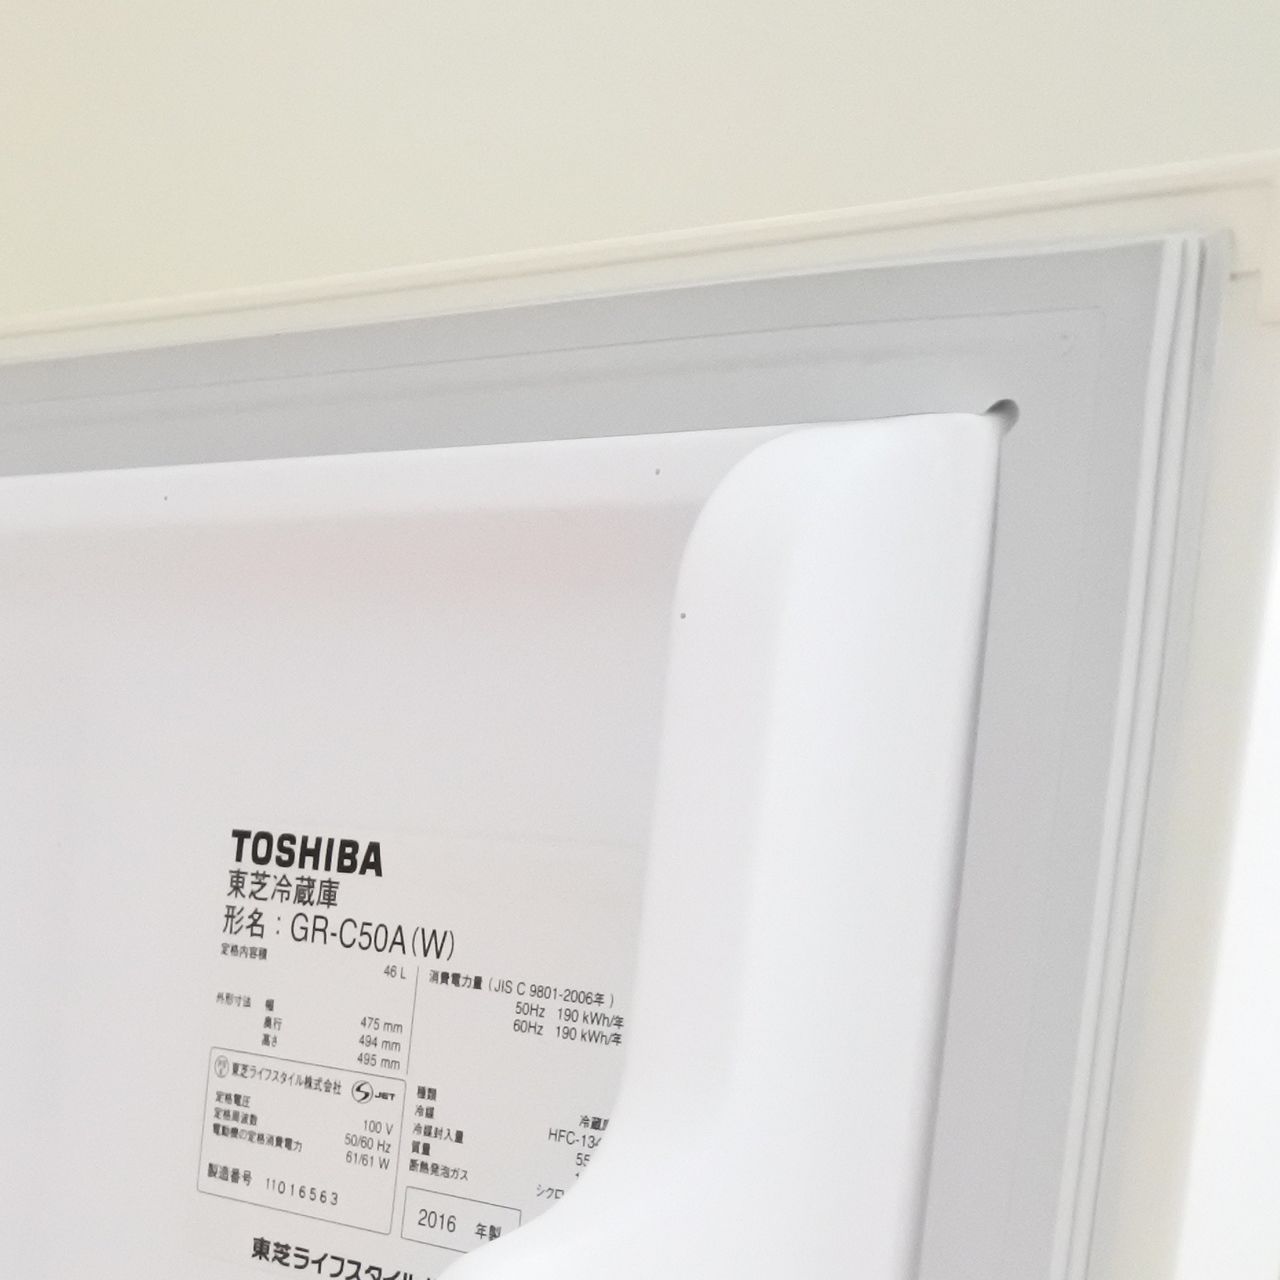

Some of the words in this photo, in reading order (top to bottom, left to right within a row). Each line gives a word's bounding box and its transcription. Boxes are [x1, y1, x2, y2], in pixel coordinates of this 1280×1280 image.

[232, 829, 383, 877] TOSHIBA
[227, 868, 340, 909] 東芝冷蔵庫
[383, 965, 397, 979] 46
[400, 967, 407, 980] L
[515, 1001, 545, 1018] 50Hz
[557, 1008, 579, 1023] 190
[360, 1016, 380, 1031] 475
[383, 1022, 403, 1034] mm
[513, 1019, 544, 1036] 60Hz
[555, 1026, 577, 1041] 190
[358, 1034, 378, 1049] 494
[381, 1039, 401, 1052] mm
[357, 1052, 377, 1067] 495
[380, 1058, 400, 1070] mm
[374, 1091, 396, 1101] JET
[363, 1119, 382, 1134] 100
[385, 1123, 393, 1135] V
[344, 1133, 373, 1150] 50/60
[377, 1139, 391, 1153] Hz
[345, 1151, 374, 1167] 61/61
[378, 1156, 390, 1170] W
[417, 1208, 457, 1233] 2016
